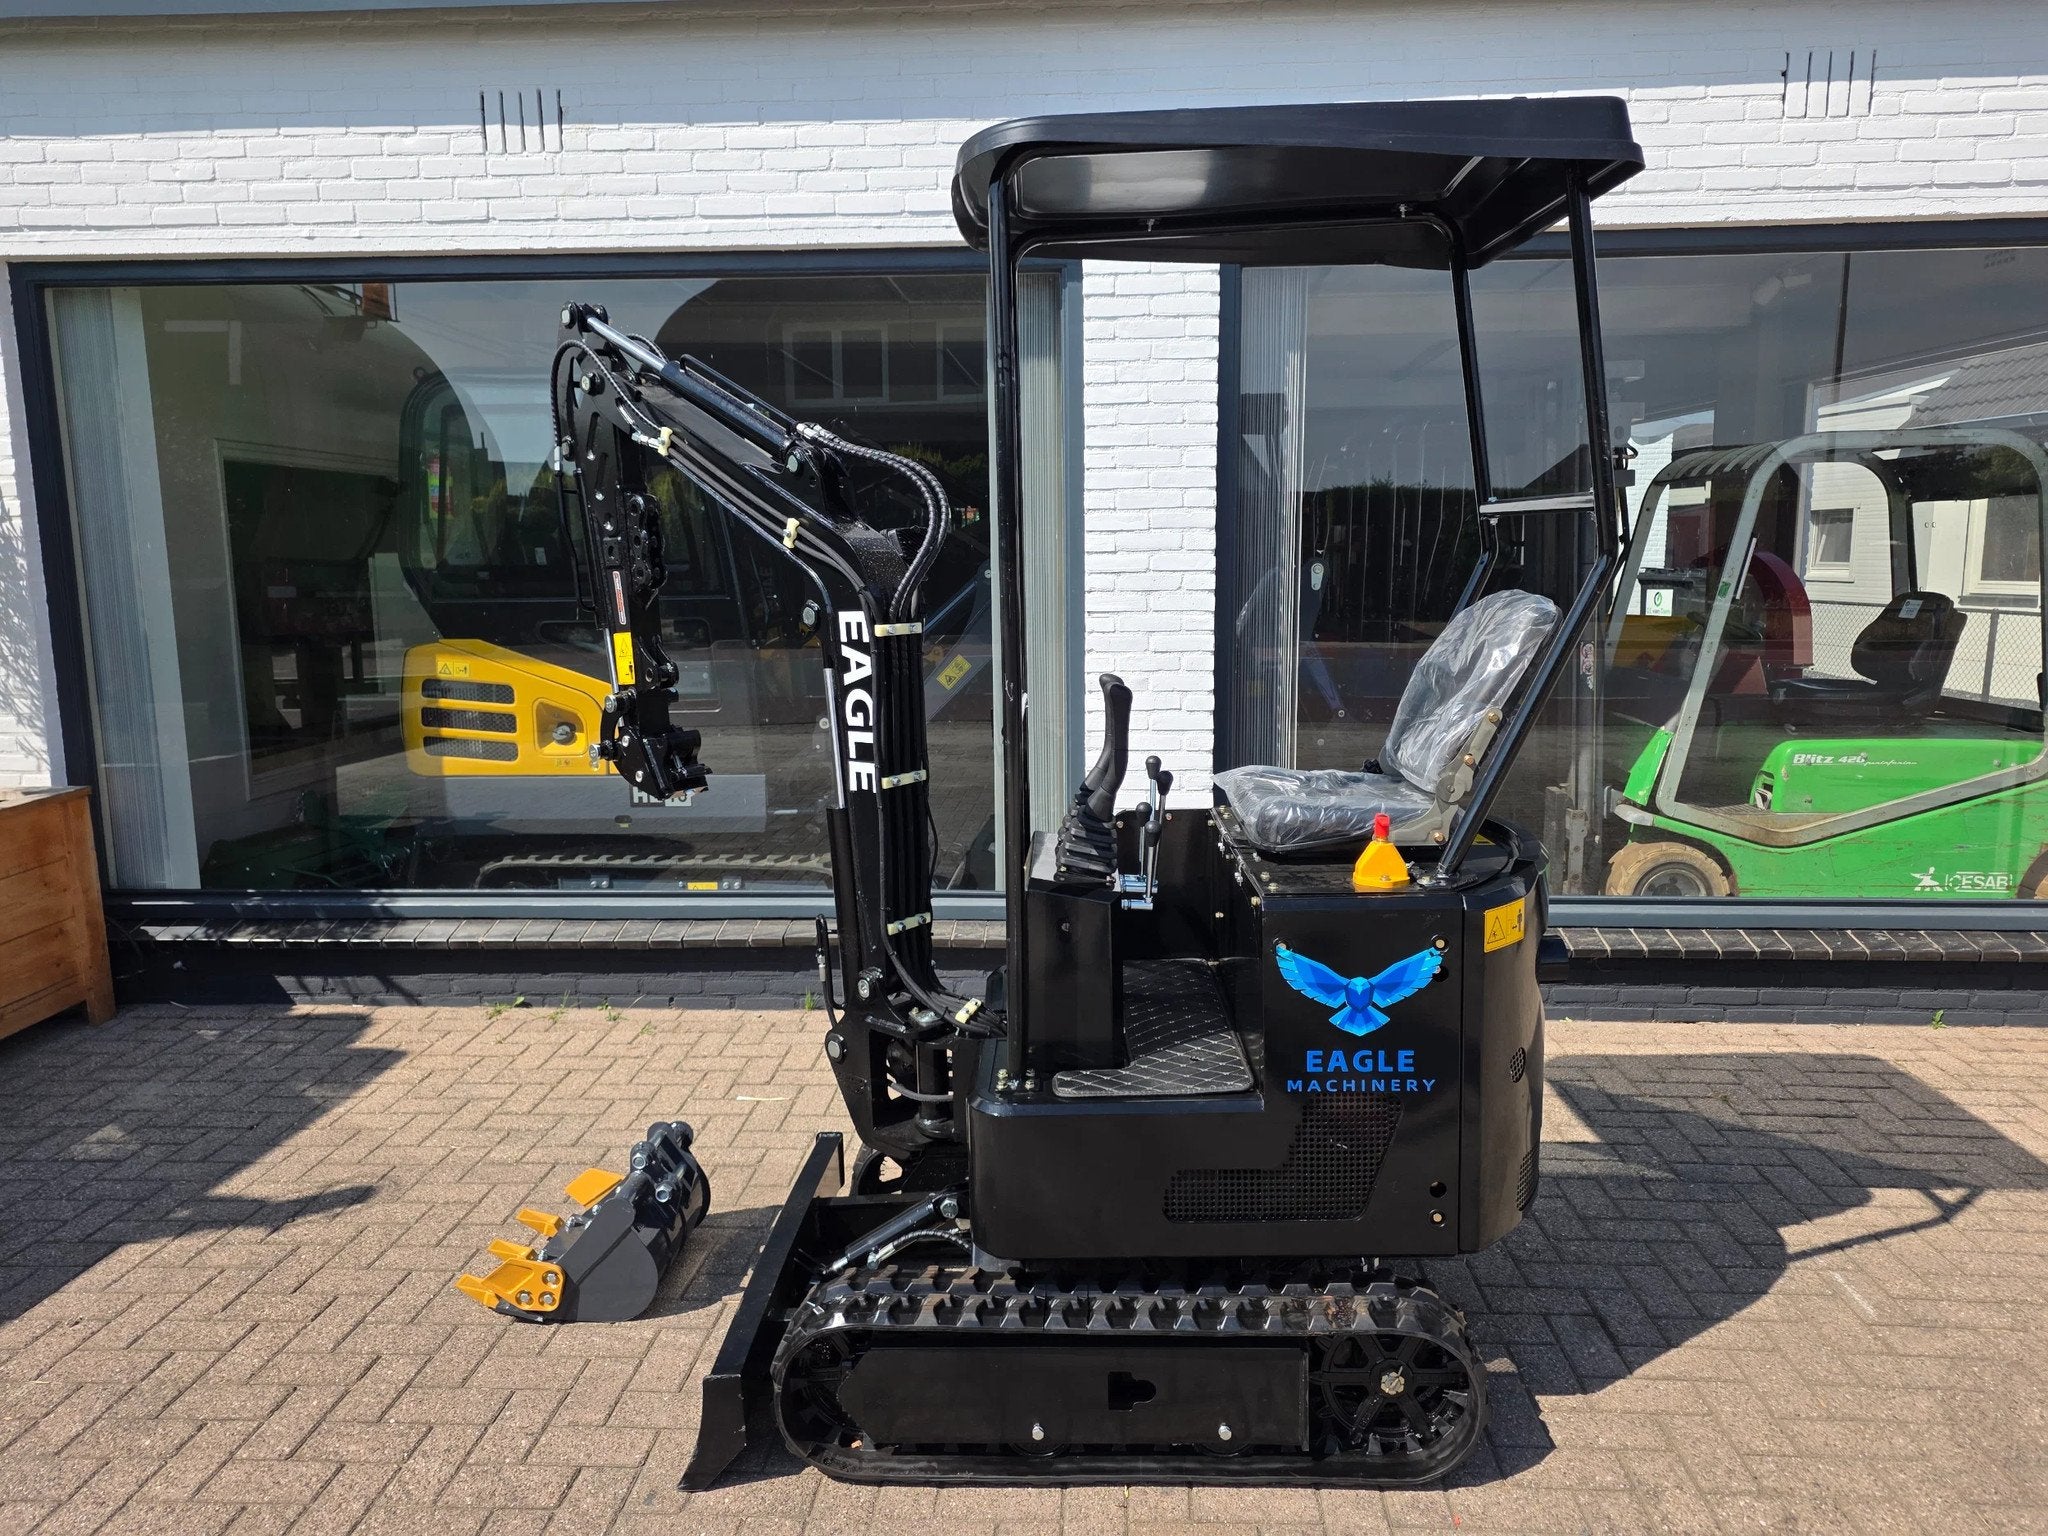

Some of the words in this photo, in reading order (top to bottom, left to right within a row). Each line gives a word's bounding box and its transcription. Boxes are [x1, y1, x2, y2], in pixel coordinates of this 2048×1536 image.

[838, 610, 878, 794] EAGLE
[1793, 753, 1834, 765] Blitz
[1948, 874, 2008, 890] CESAB
[1306, 1050, 1415, 1073] EAGLE
[1286, 1079, 1437, 1093] MACHINERY
